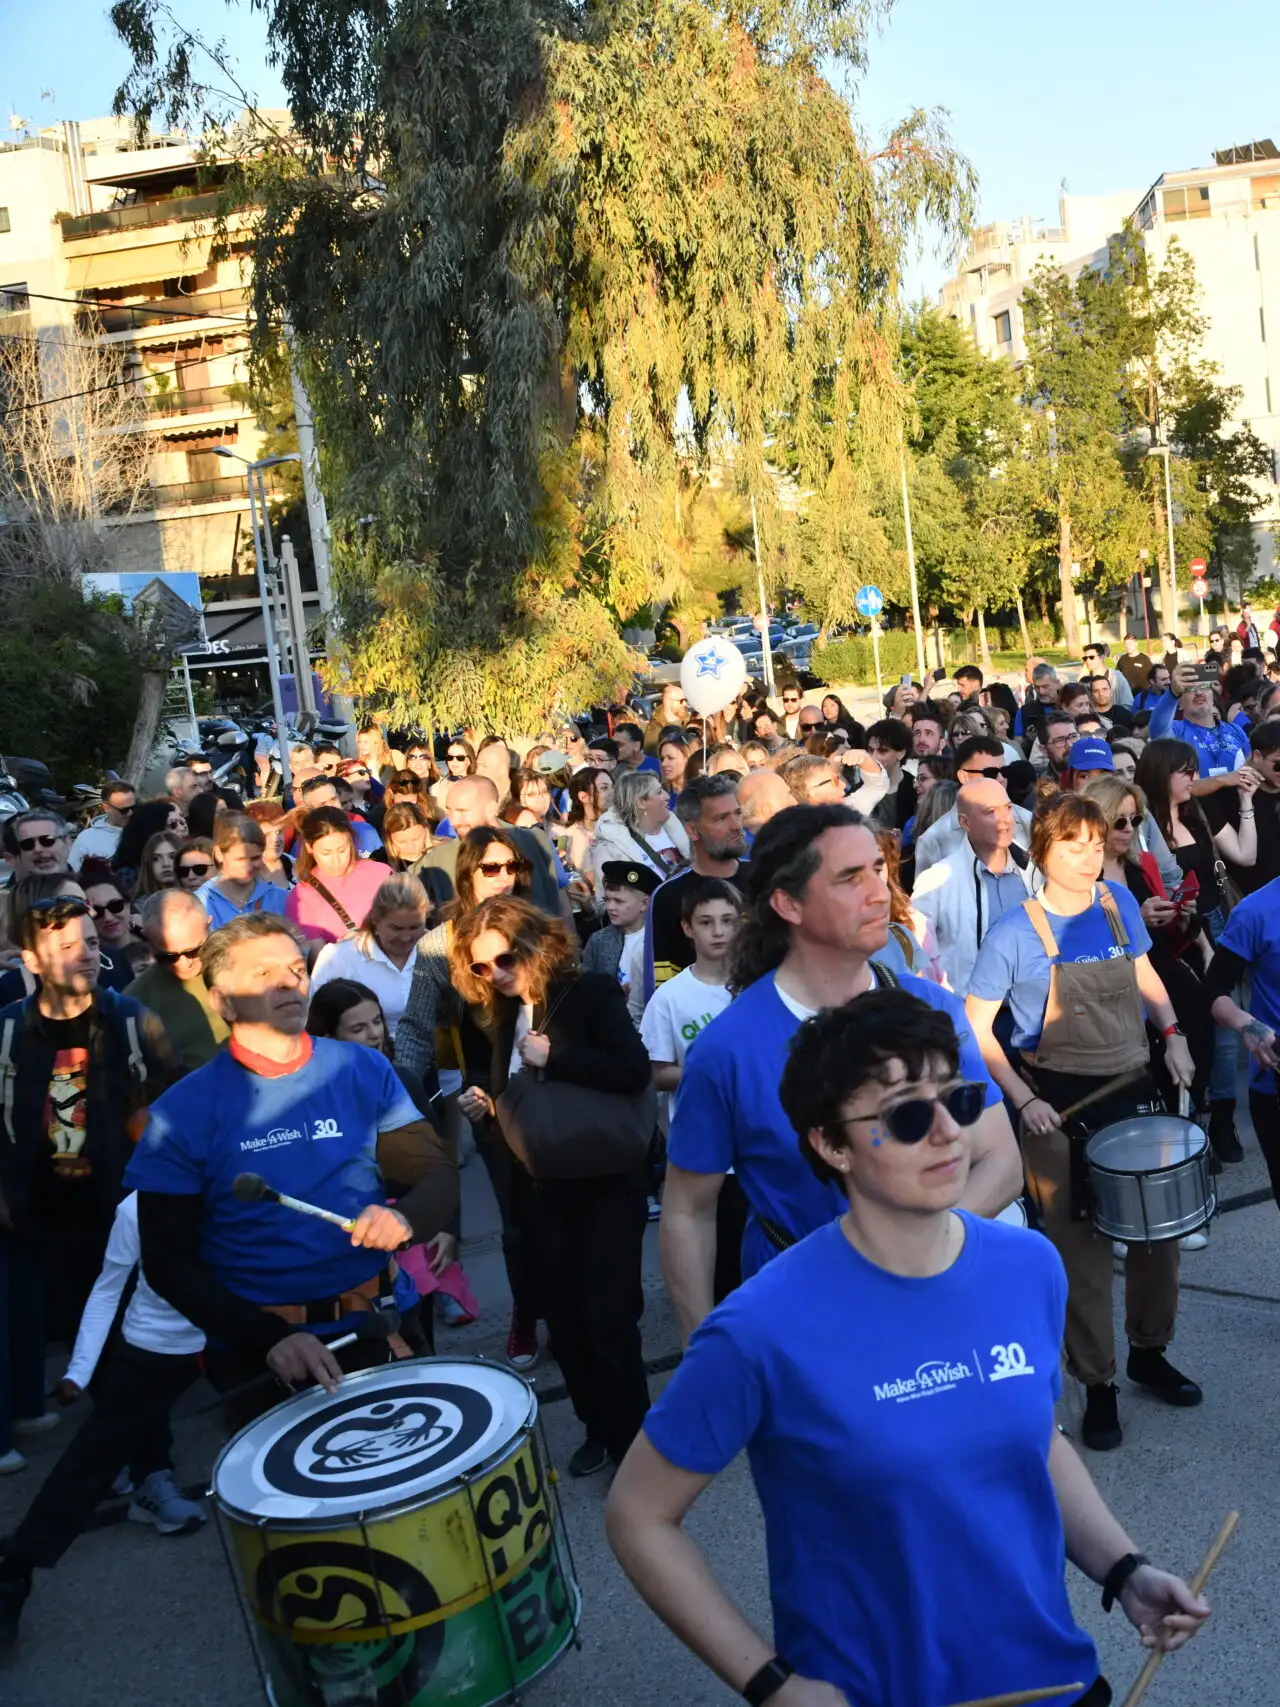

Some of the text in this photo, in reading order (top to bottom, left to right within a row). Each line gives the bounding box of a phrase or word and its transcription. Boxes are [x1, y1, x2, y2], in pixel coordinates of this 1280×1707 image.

[313, 1119, 340, 1137] 30
[873, 1361, 973, 1401] Make-A-Wish
[990, 1342, 1030, 1378] 30
